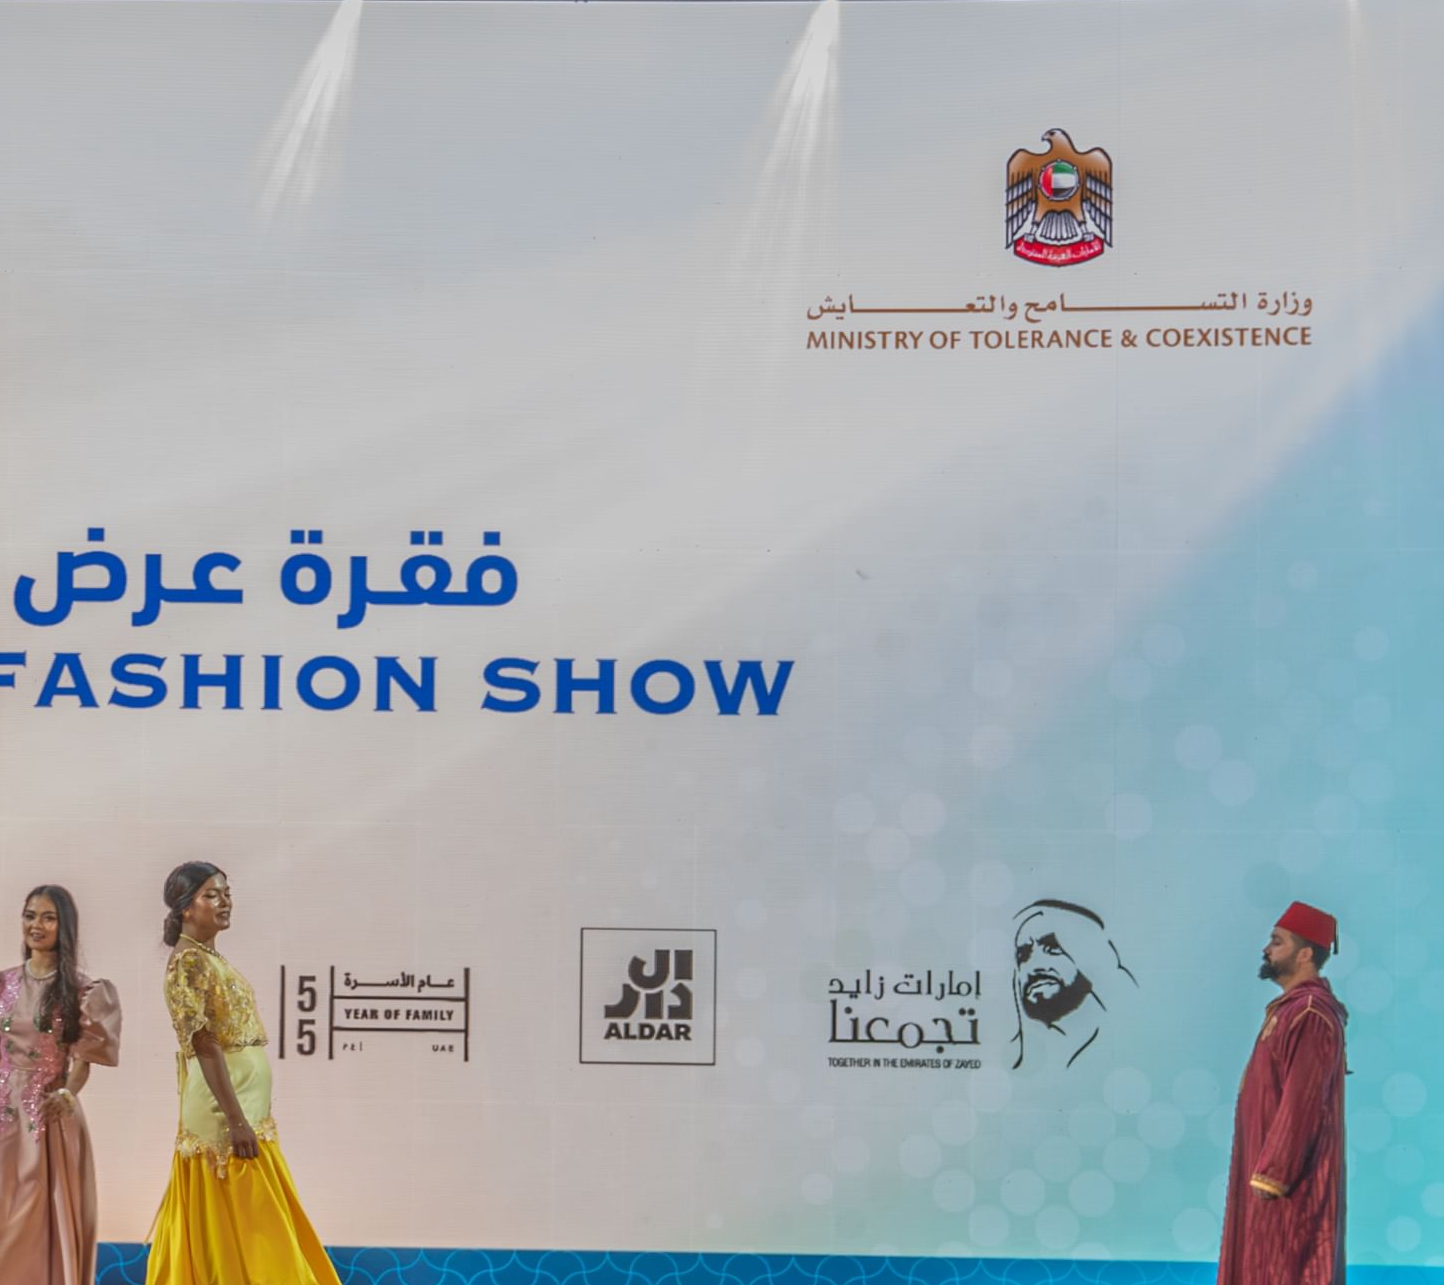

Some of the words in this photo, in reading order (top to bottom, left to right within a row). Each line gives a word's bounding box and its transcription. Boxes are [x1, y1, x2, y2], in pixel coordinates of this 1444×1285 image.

[1257, 291, 1314, 316] وزارة
[806, 330, 924, 350] MINISTRY
[929, 330, 962, 350] OF
[969, 328, 1113, 349] TOLERANCE
[1120, 328, 1138, 348] &
[1146, 326, 1313, 348] COEXISTENCE
[13, 526, 245, 628] عرض
[280, 528, 519, 630] فقرة
[481, 655, 795, 716] SHOW
[297, 975, 318, 1013] 5
[344, 1008, 380, 1020] YEAR
[384, 1009, 401, 1020] OF
[405, 1009, 454, 1022] FAMILY
[296, 1018, 317, 1056] 5
[603, 1022, 692, 1041] ALDAR
[431, 1044, 455, 1053] UAE
[828, 1057, 871, 1068] TOGETHER
[873, 1058, 881, 1068] IN
[883, 1058, 898, 1068] THE
[900, 1058, 941, 1069] EMIRATES
[943, 1059, 953, 1069] OF
[955, 1059, 982, 1070] ZAYED
